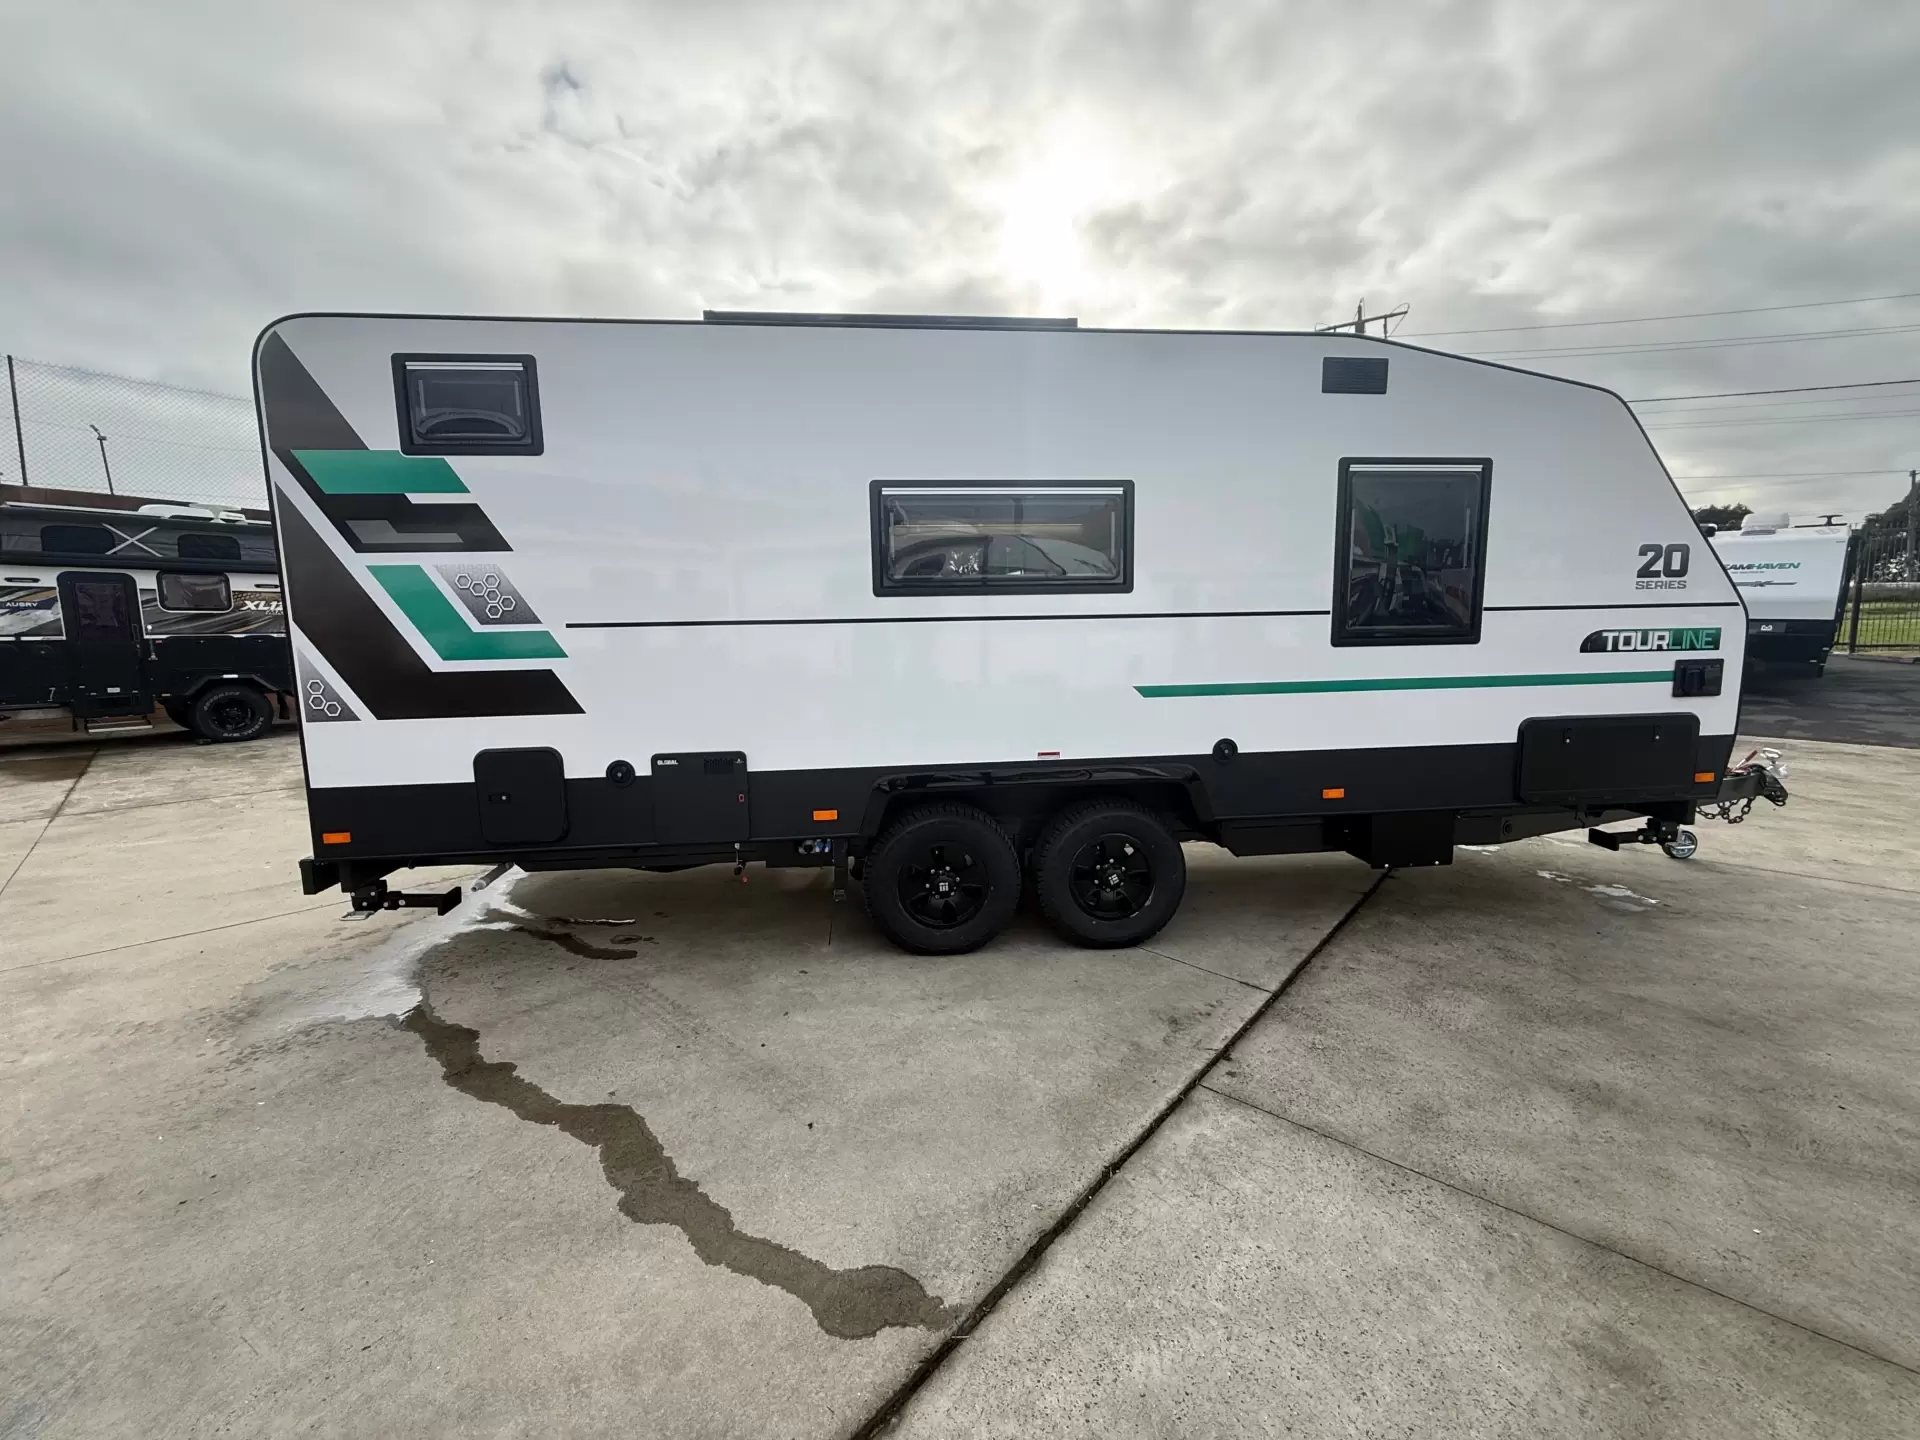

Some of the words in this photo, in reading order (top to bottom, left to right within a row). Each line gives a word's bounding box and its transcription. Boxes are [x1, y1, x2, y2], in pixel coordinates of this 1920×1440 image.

[1636, 543, 1690, 579] 20
[1635, 579, 1687, 590] SERIES
[1601, 629, 1717, 651] TOURLINE
